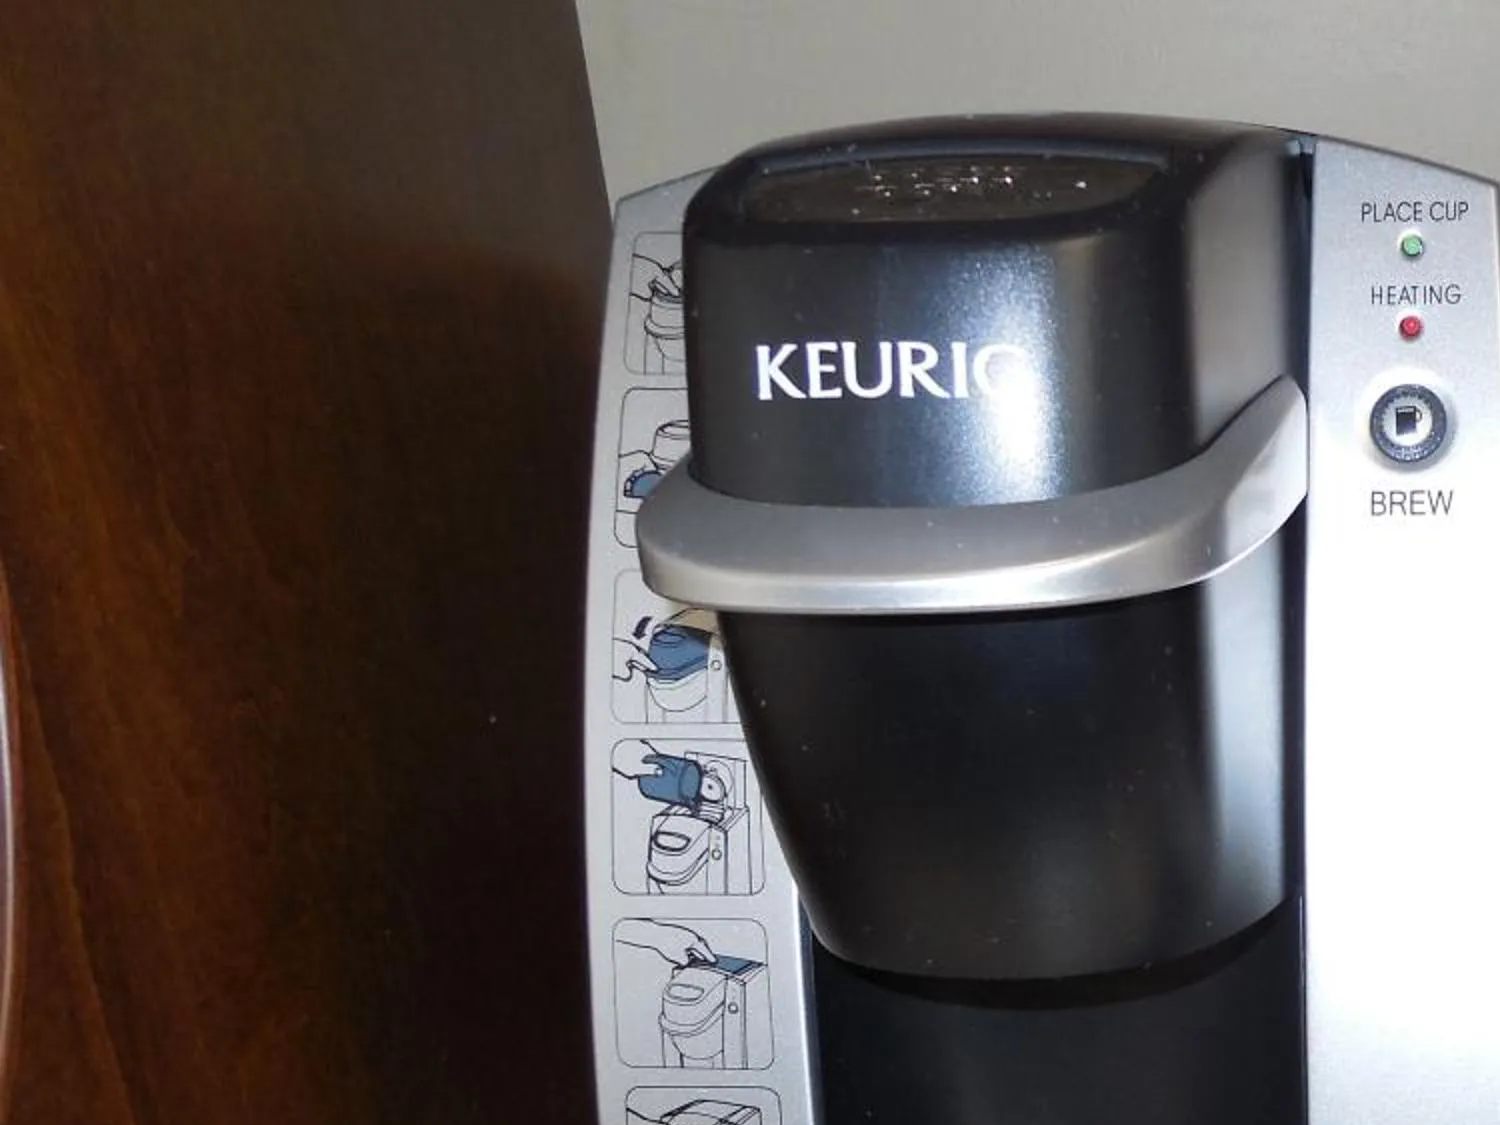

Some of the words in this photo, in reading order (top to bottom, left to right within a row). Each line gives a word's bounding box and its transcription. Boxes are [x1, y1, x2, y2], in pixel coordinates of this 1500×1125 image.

[1361, 201, 1423, 222] PLACE
[1429, 201, 1469, 222] CUP
[1371, 283, 1462, 305] HEATING
[1371, 490, 1454, 516] BREW
